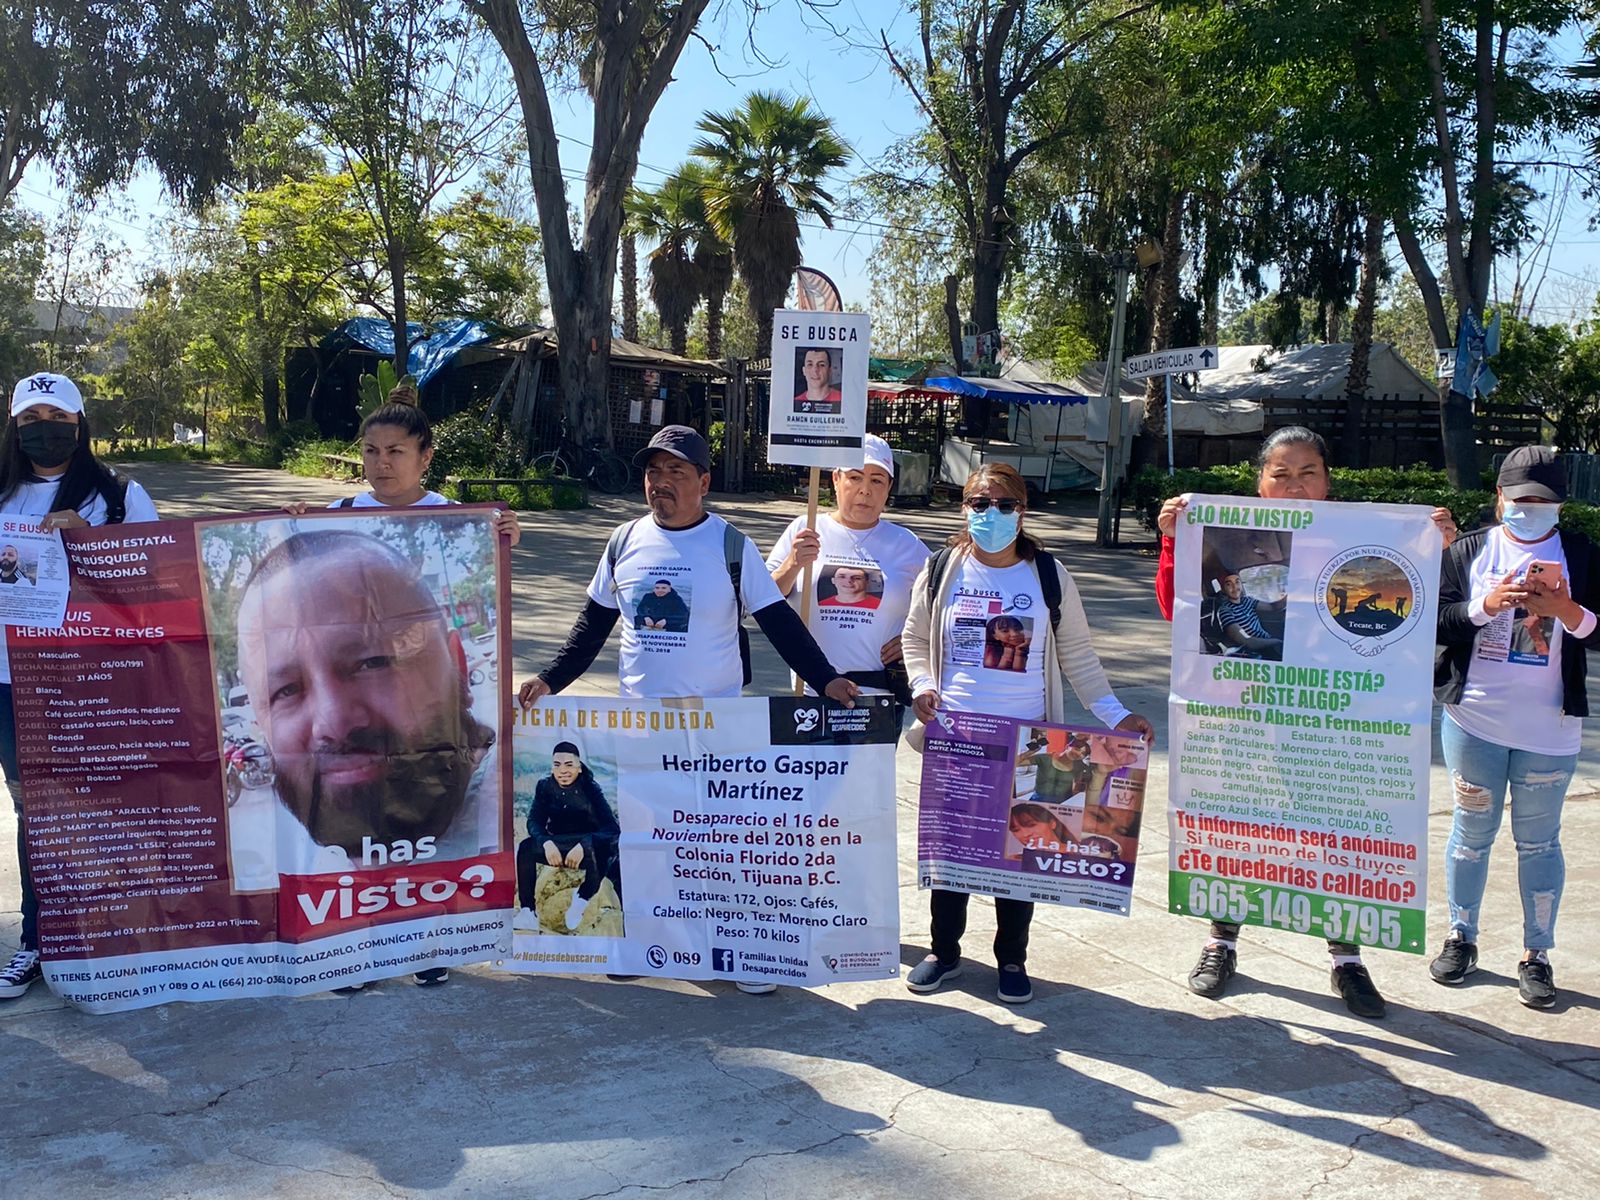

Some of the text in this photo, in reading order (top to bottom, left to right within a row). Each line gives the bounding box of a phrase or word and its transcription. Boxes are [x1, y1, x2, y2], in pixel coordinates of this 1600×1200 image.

[782, 326, 857, 341] SE BUSCA
[1129, 354, 1193, 374] SALIDA VEHICULAR
[28, 377, 56, 394] NY
[1187, 505, 1215, 525] ¿LO
[1219, 507, 1250, 526] HAZ
[3, 522, 16, 531] SE
[66, 535, 176, 551] COMISIÓN ESTATAL
[71, 552, 148, 565] DE BÚSQUEDA
[77, 567, 147, 579] DE PERSONAS
[960, 587, 1000, 597] Se busca
[66, 611, 92, 622] UIS
[1348, 621, 1373, 630] Tecate,
[115, 627, 164, 638] REYES
[1212, 660, 1385, 693] ¿SABES DONDE ESTÁ?
[1241, 685, 1351, 712] ¿VISTE ALGO?
[513, 707, 714, 731] FICHA DE BÚSQUEDA
[1186, 701, 1411, 736] Alexandro Abarca Fernandez
[1199, 720, 1226, 731] Edad:
[1229, 724, 1240, 733] 20
[954, 742, 983, 750] YESENIA
[1291, 731, 1384, 748] Estatura: 1.68 mts
[950, 748, 985, 756] MENDOZA
[662, 754, 848, 780] Heriberto Gaspar
[707, 780, 804, 801] Martínez
[1253, 797, 1262, 805] el
[1264, 798, 1275, 807] 17
[1278, 800, 1290, 808] de
[1294, 802, 1344, 816] Diciembre
[1347, 809, 1362, 818] del
[673, 810, 839, 828] Desaparecio el 16 de
[1200, 801, 1225, 812] Cerro
[1228, 805, 1249, 815] Azul
[1282, 811, 1325, 826] Encinos,
[1328, 817, 1371, 833] CIUDAD,
[1375, 824, 1396, 835] B.C.
[652, 827, 861, 847] Noviembre del 2018 en la
[1176, 809, 1416, 859] Tu información será anónima
[361, 835, 437, 866] has
[1026, 837, 1100, 855] ¿La has
[1187, 830, 1406, 877] Si fuera uno de los tuyos
[675, 846, 835, 867] Colonia Florido 2da
[673, 864, 840, 887] Sección, Tijuana B.C.
[1035, 853, 1126, 881] visto?
[1178, 848, 1416, 903] ¿Te quedarías callado?
[297, 864, 495, 926] visto?
[678, 889, 838, 911] Estatura: 172, Ojos: Cafés,
[653, 905, 868, 927] Cabello: Negro, Tez: Moreno Claro
[1188, 876, 1401, 949] 665-149-3795
[716, 926, 800, 944] Peso: 70 kilos
[51, 974, 58, 982] SI
[60, 972, 91, 982] TIENES
[94, 967, 138, 980] ALGUNA
[140, 958, 218, 975] INFORMACIÓN
[221, 956, 244, 967] QUE
[246, 955, 279, 964] AYUDE
[286, 945, 356, 965] LOCALIZARLO,
[358, 931, 424, 951] COMUNÍCATE
[435, 927, 453, 937] LOS
[456, 921, 504, 934] NÚMEROS
[673, 951, 701, 965] 089
[739, 951, 809, 967] Familias Unidas
[75, 988, 140, 1003] EMERGENCIA
[142, 985, 157, 995] 911
[168, 982, 188, 990] 089
[202, 981, 216, 989] AL
[218, 977, 245, 988] (664)
[294, 974, 316, 985] POR
[318, 964, 362, 980] CORREO
[364, 962, 371, 970] A
[373, 942, 496, 967] busquedabc@baja.gob.mx
[741, 963, 807, 978] Desaparecidos
